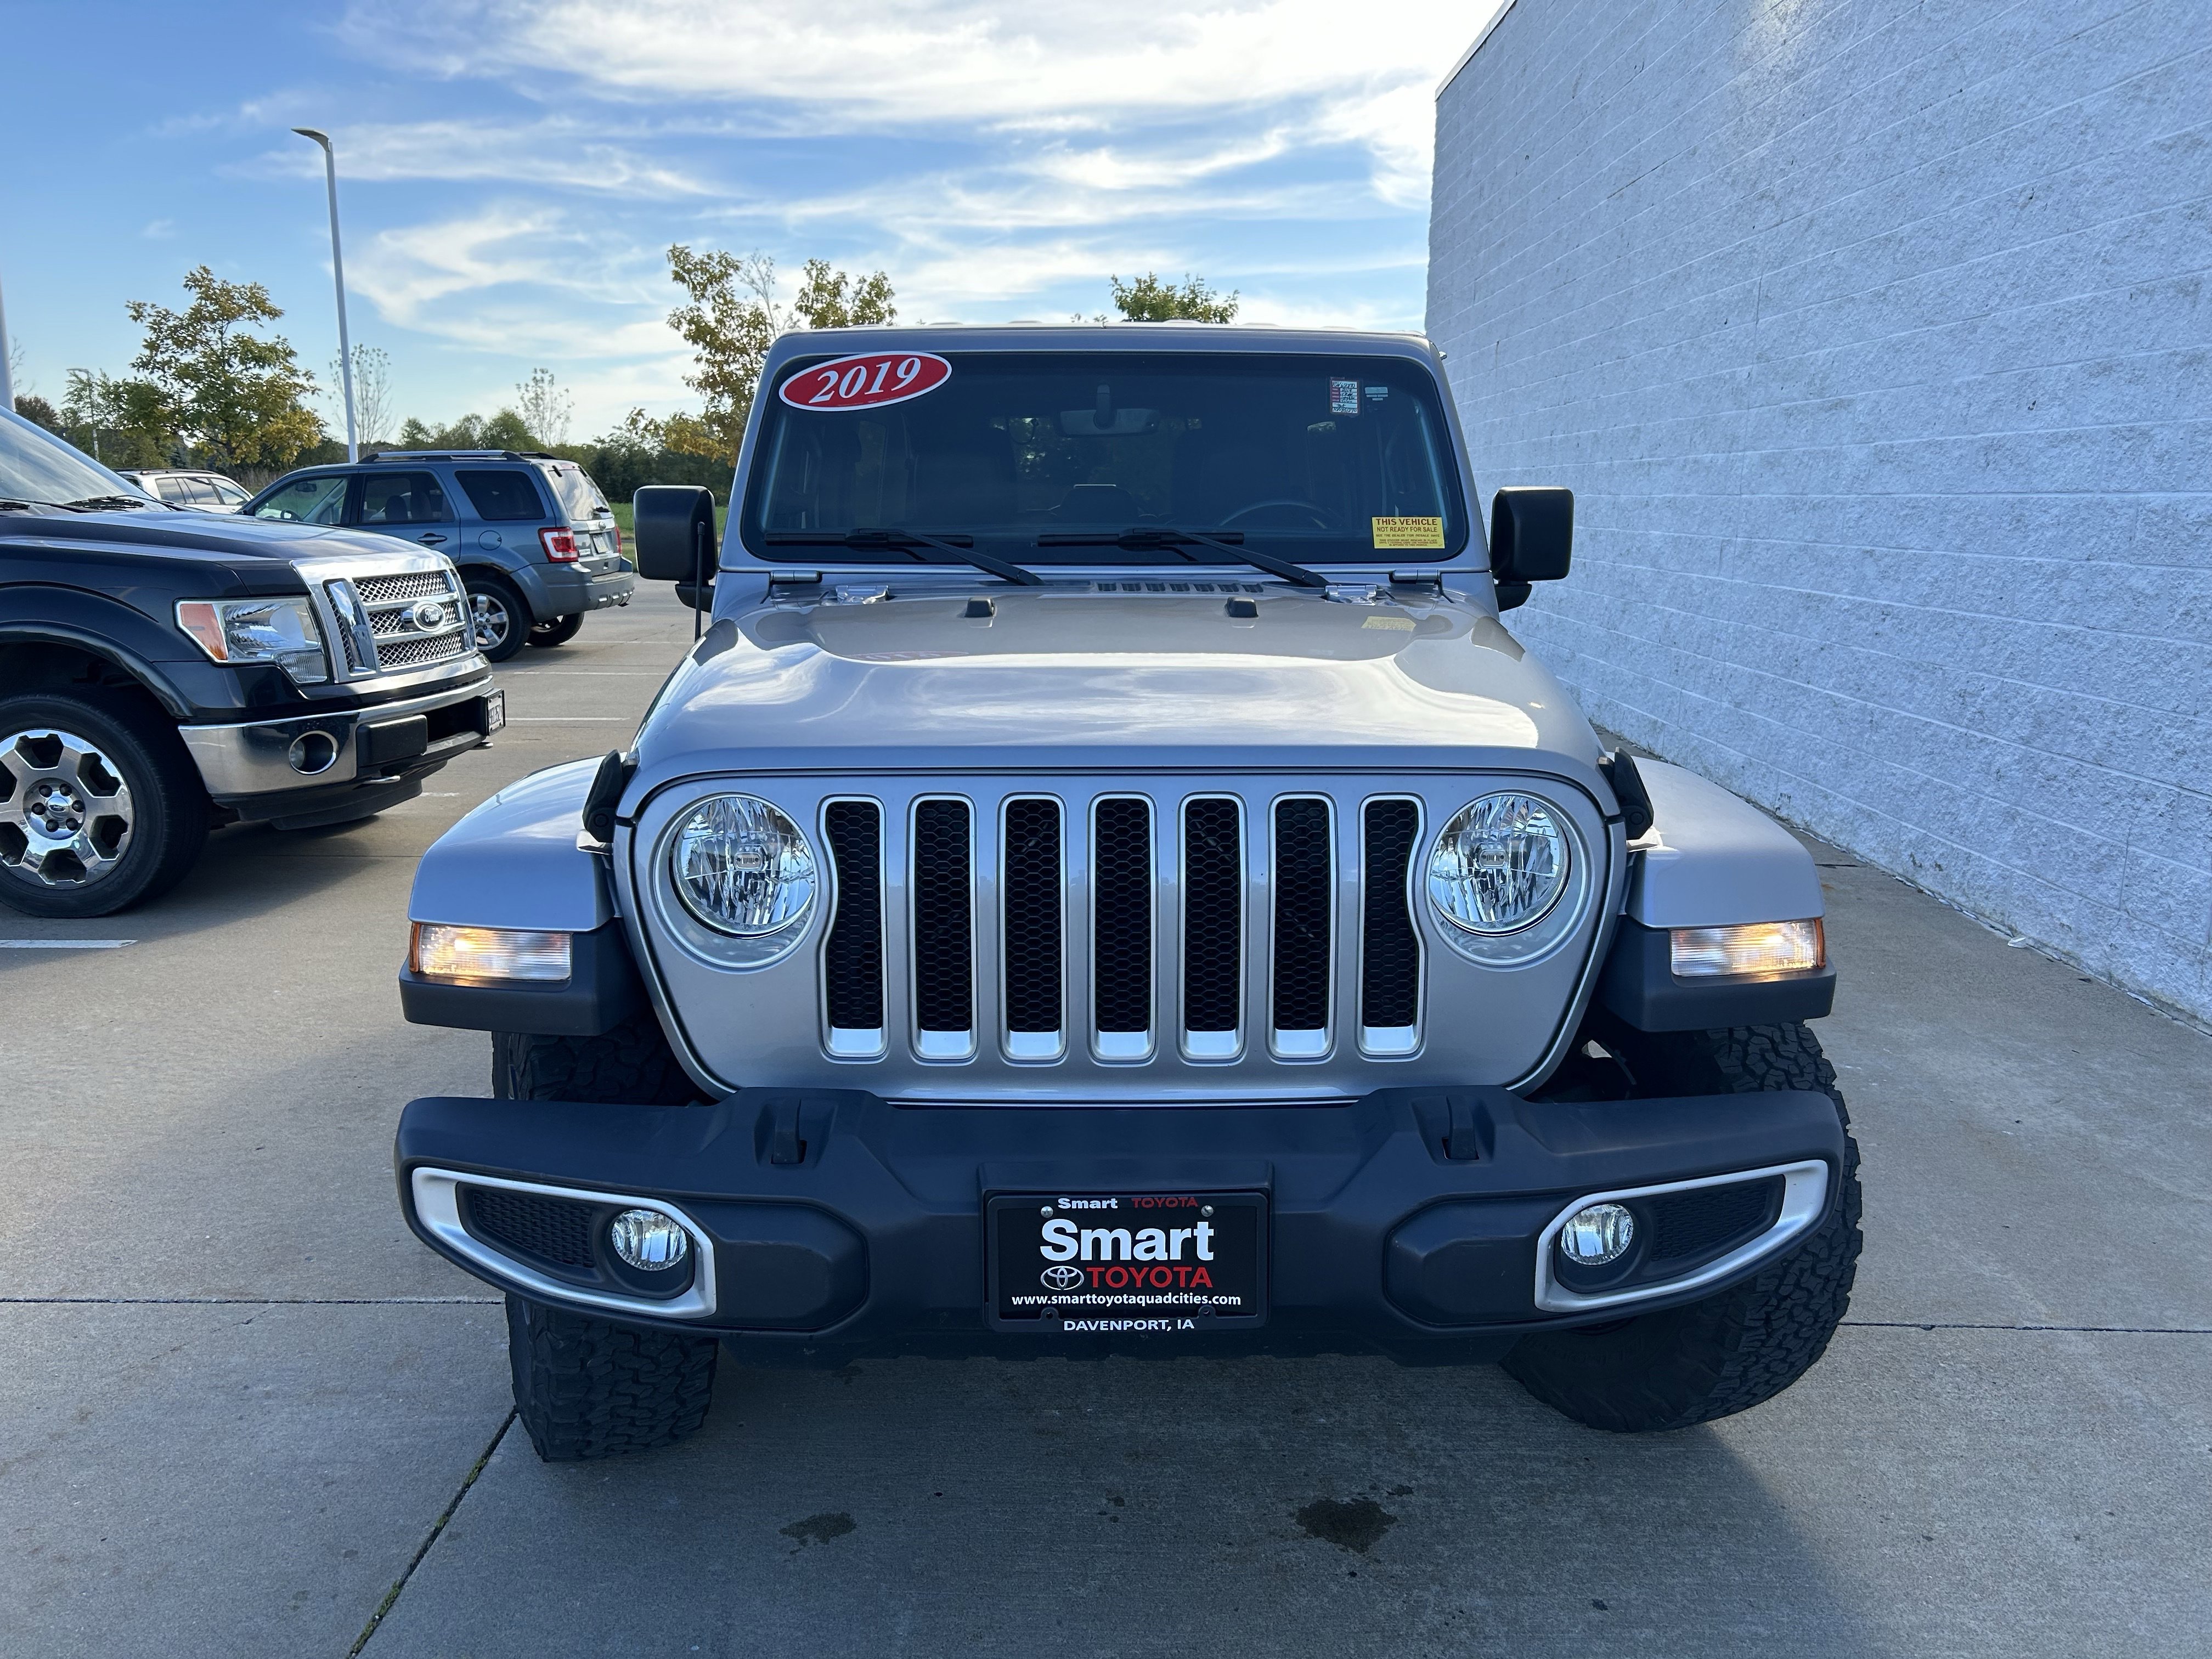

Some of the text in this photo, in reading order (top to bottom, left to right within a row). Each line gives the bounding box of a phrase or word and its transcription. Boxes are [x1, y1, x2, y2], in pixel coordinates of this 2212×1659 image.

[808, 357, 922, 404] 2019
[424, 608, 439, 623] Ford
[1058, 1197, 1198, 1209] Smart TOYOTA
[1040, 1218, 1214, 1261] Smart
[1086, 1266, 1213, 1288] TOYOTA
[1012, 1292, 1241, 1307] www.smarttoyotaquadcities.com
[1064, 1319, 1195, 1331] DAVENPORT, IA
